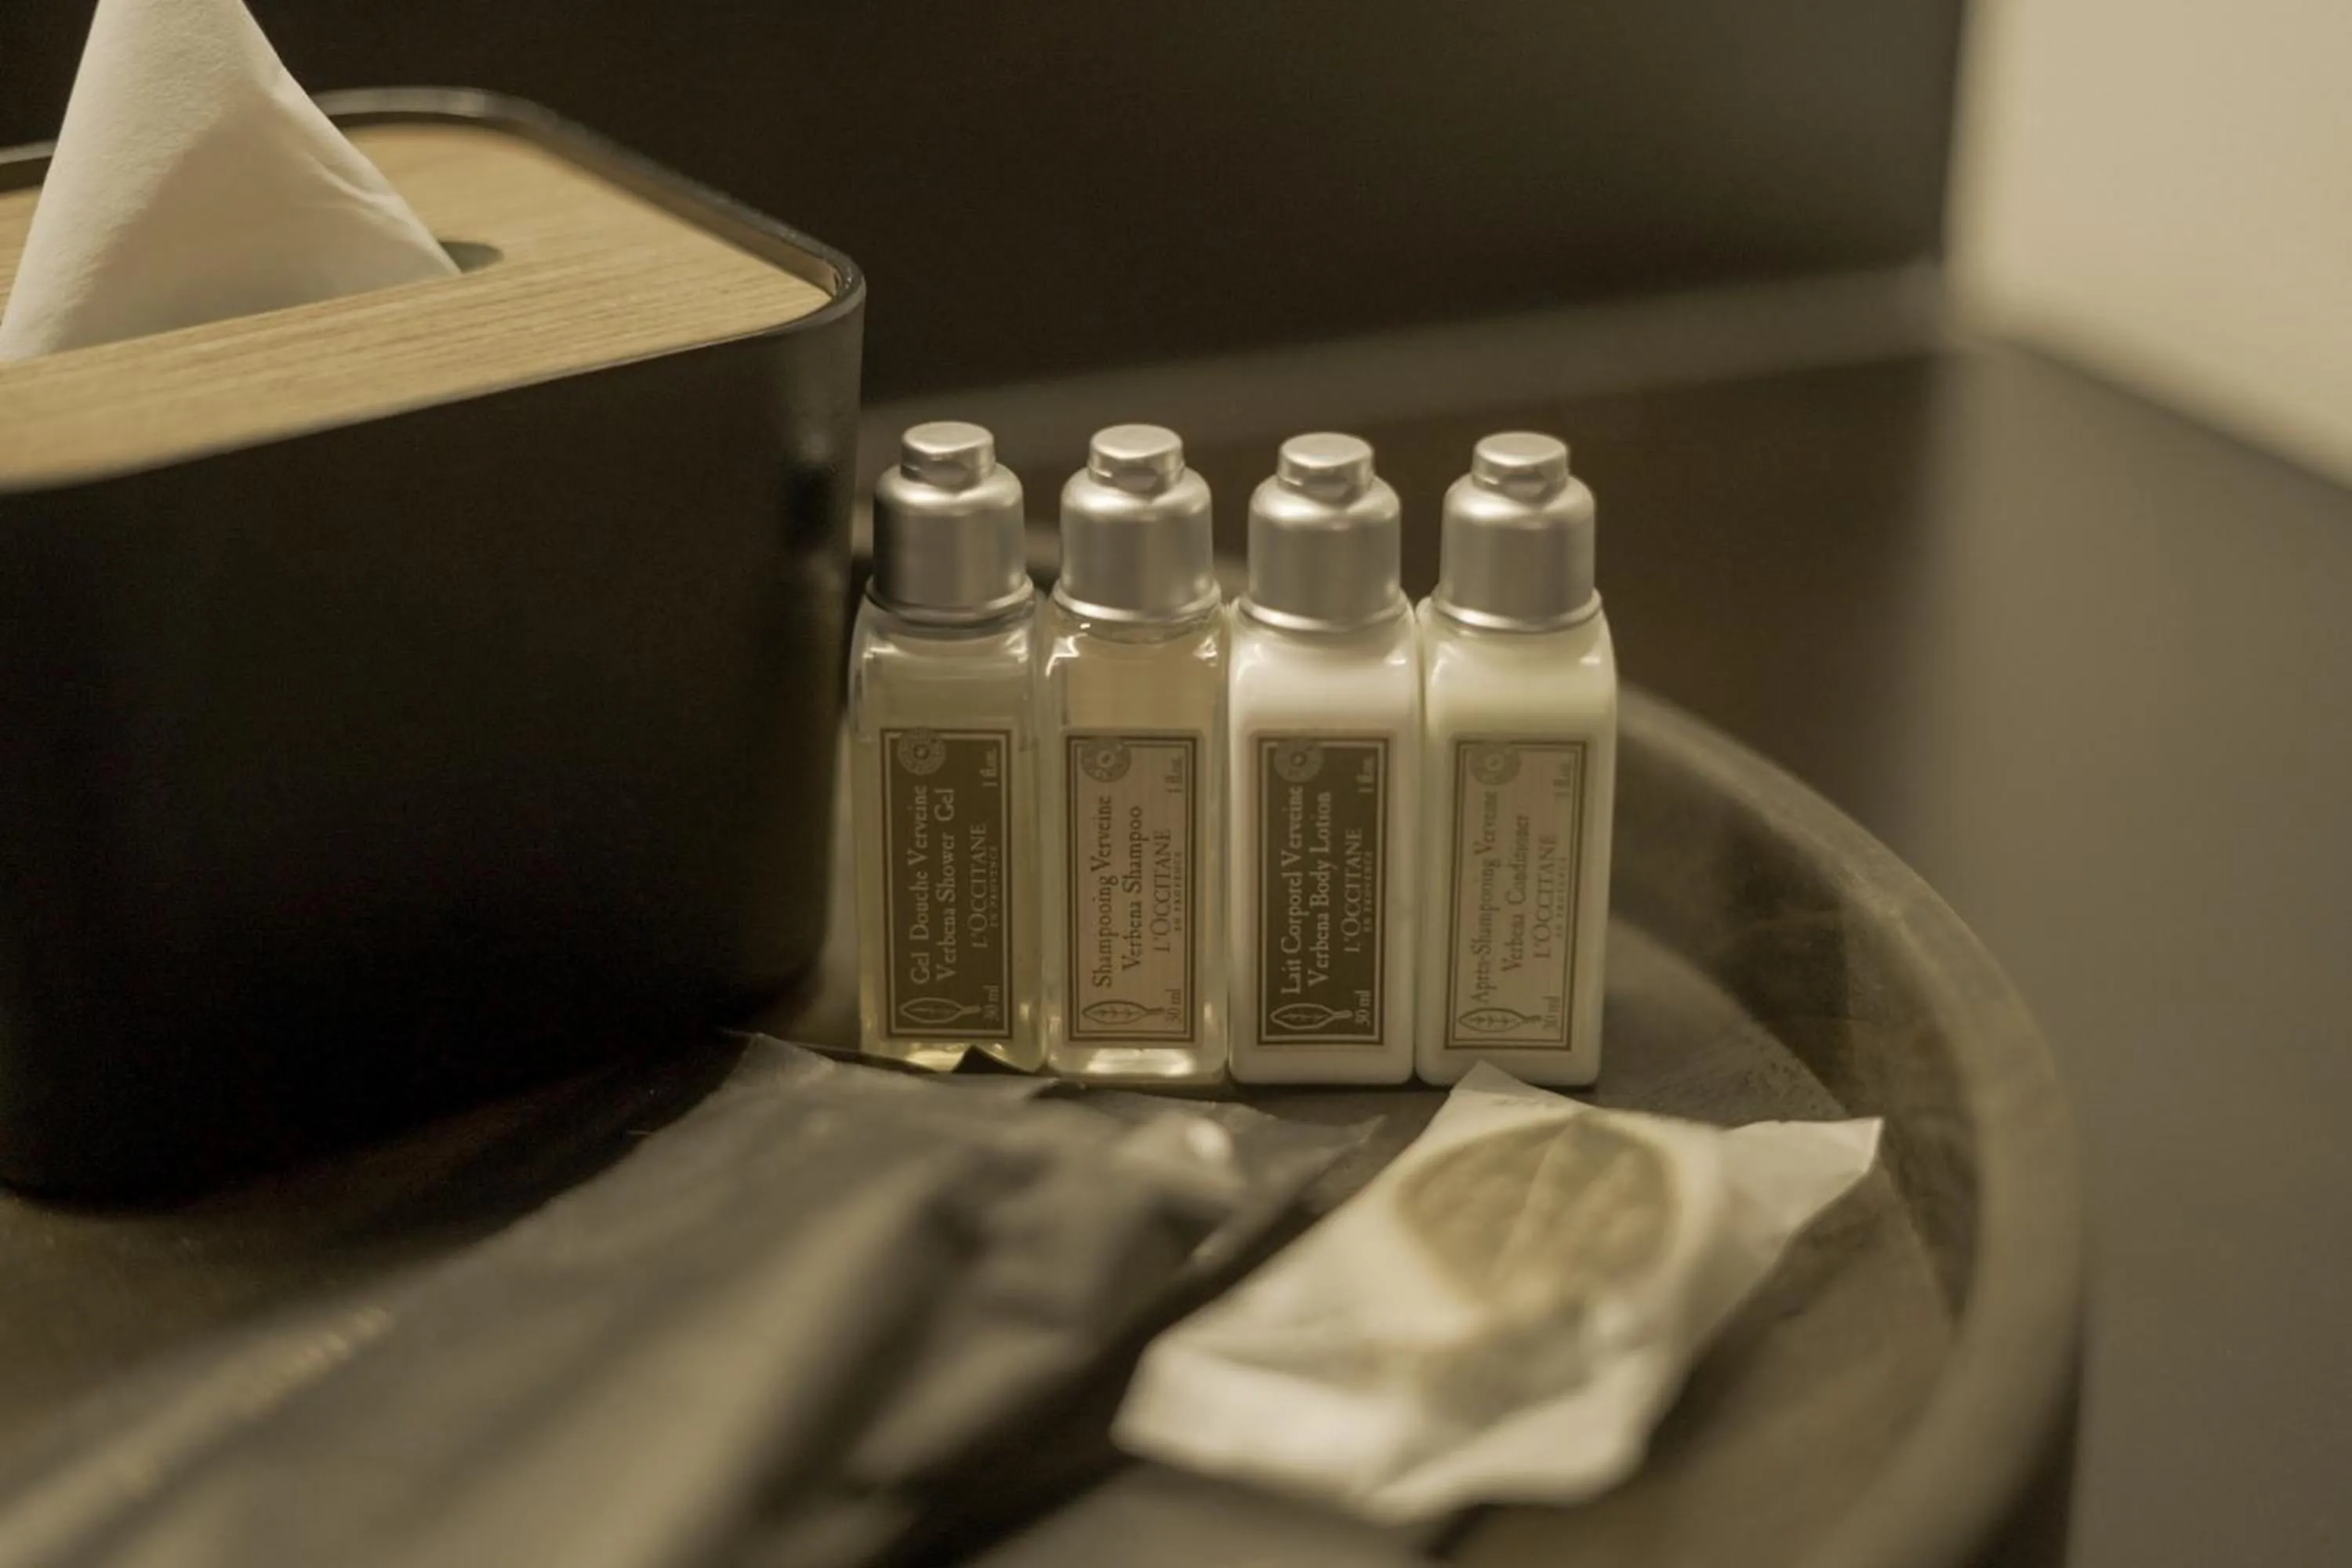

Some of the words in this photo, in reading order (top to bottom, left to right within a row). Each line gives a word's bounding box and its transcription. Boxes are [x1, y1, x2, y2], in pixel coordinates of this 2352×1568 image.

[908, 786, 927, 867] Verveine
[934, 788, 955, 822] Gel
[1090, 796, 1112, 872] Verveine
[1280, 786, 1304, 866] Verveine
[1310, 792, 1331, 853] Lotion
[936, 833, 956, 902] Shower
[1123, 806, 1148, 894] Shampoo
[1308, 859, 1337, 907] Body
[909, 871, 929, 941] Douche
[1091, 875, 1118, 989] Shampooing
[1121, 901, 1142, 971] Verbena
[1280, 871, 1308, 954] Corporel
[910, 953, 930, 984] Gel
[937, 907, 956, 981] Verbena
[1281, 960, 1301, 994] Lait
[1308, 913, 1329, 987] Verbena
